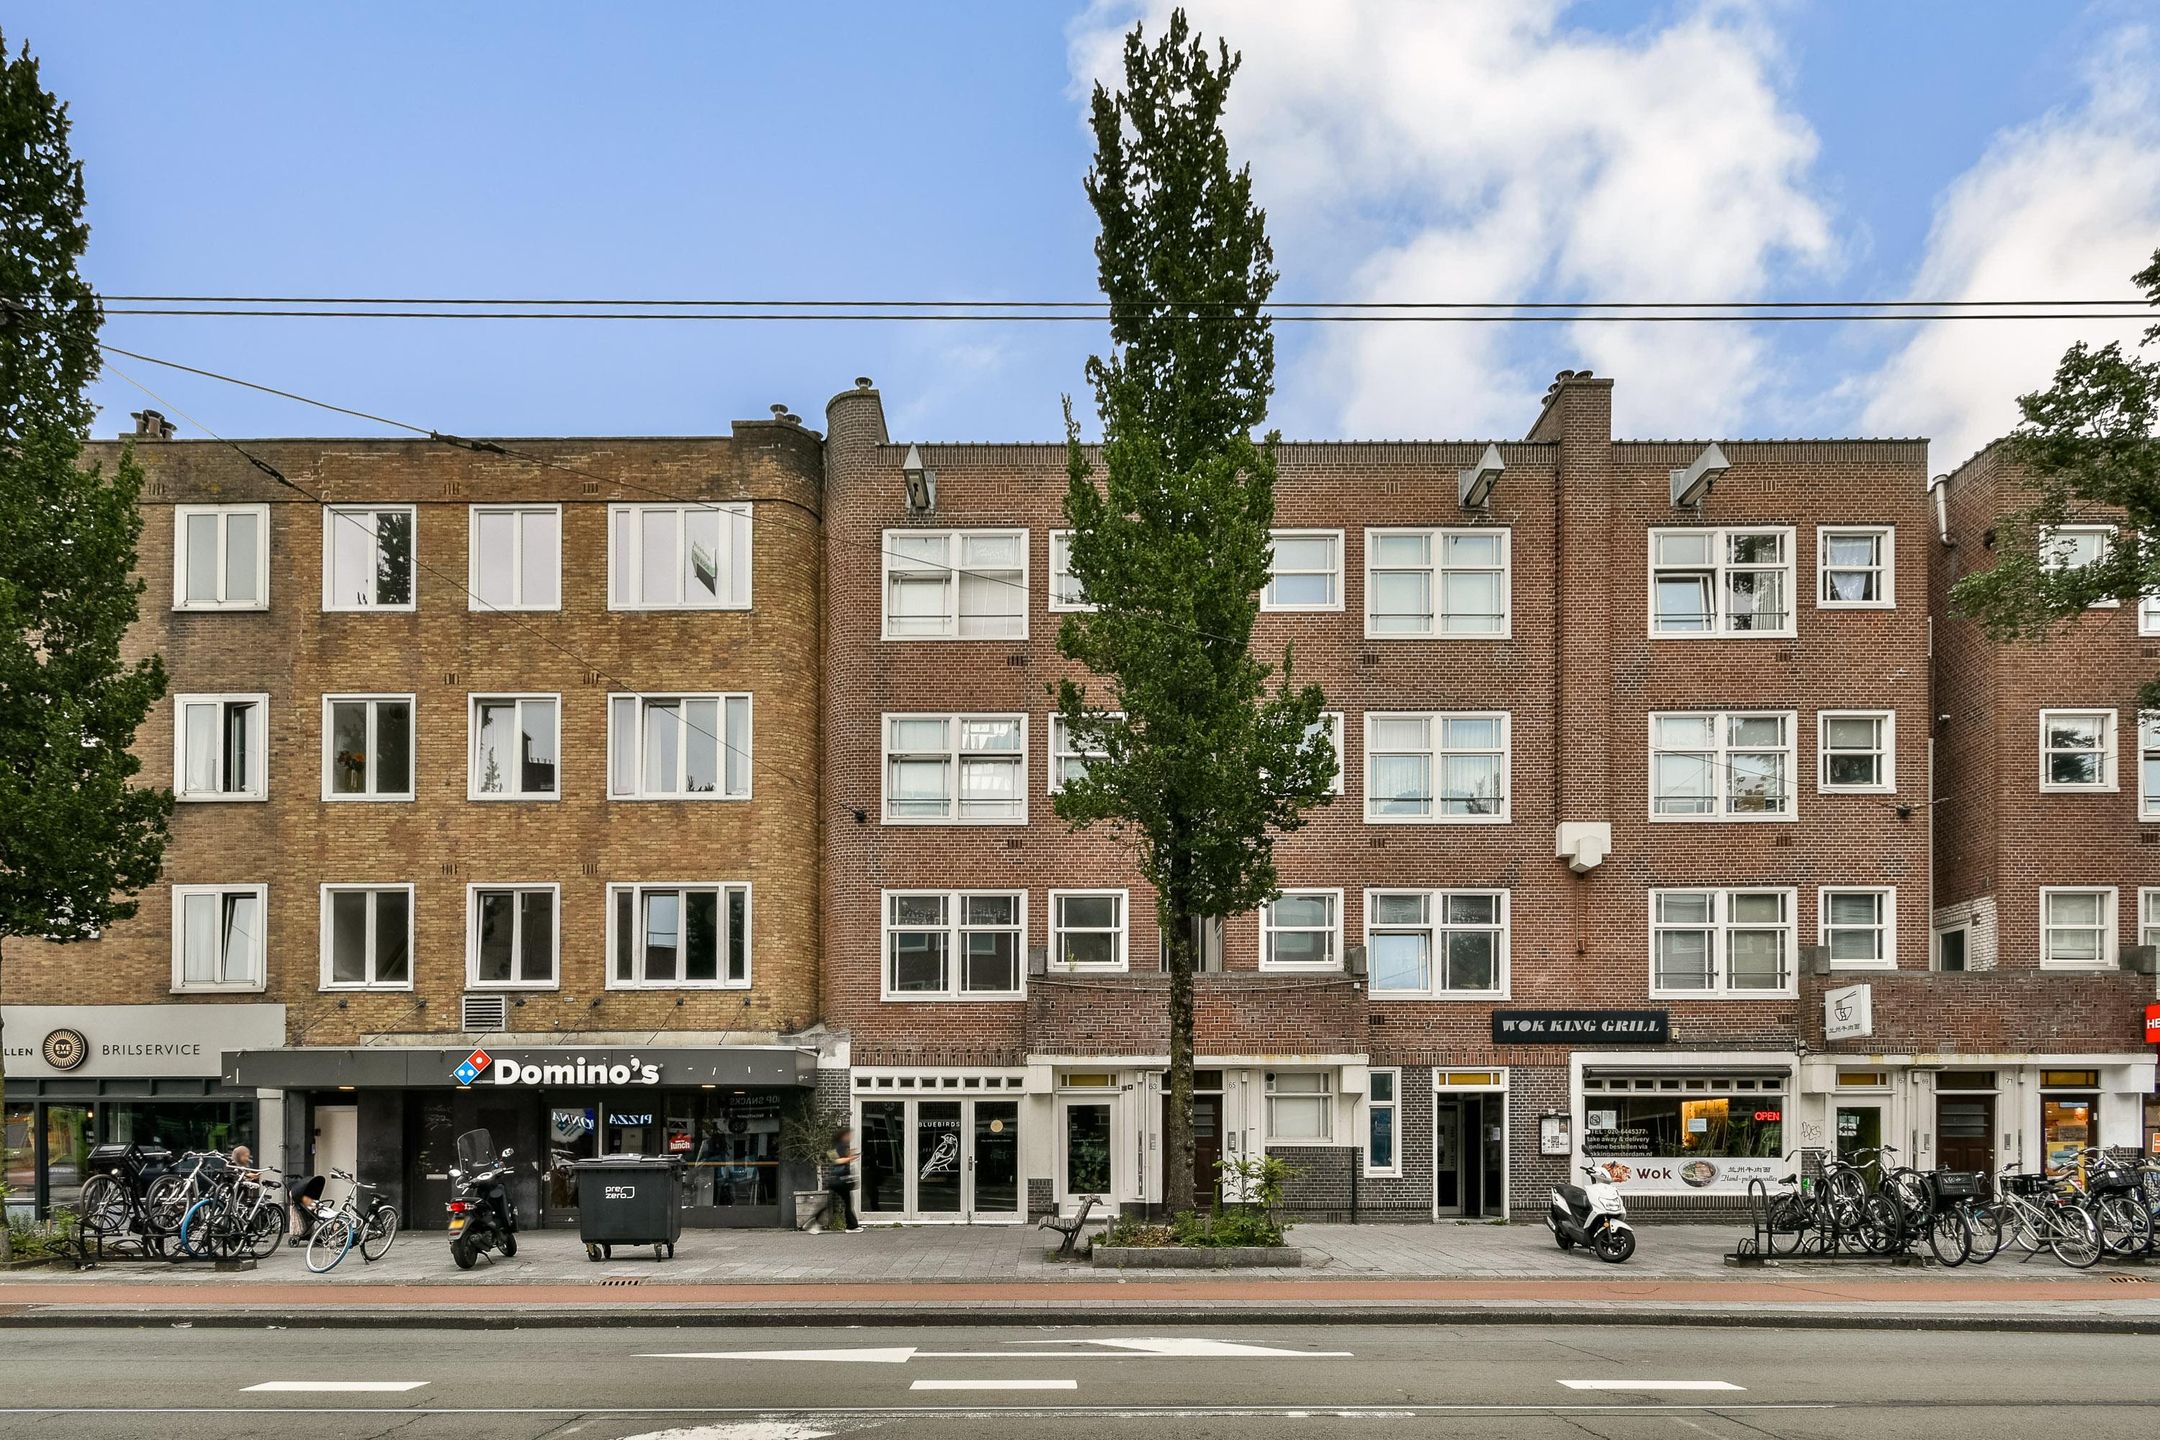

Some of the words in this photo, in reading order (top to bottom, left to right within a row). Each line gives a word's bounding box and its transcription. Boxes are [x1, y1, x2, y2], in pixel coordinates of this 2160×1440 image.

[1502, 1020, 1545, 1032] WOK
[1550, 1020, 1596, 1032] KING
[1601, 1020, 1659, 1032] GRILL
[4, 1048, 33, 1056] LLEN
[102, 1044, 200, 1056] BRILSERVICE
[494, 1056, 660, 1085] Domino's
[1755, 1112, 1780, 1120] OPEN
[670, 1140, 690, 1150] lunch
[1636, 1168, 1672, 1180] Wok
